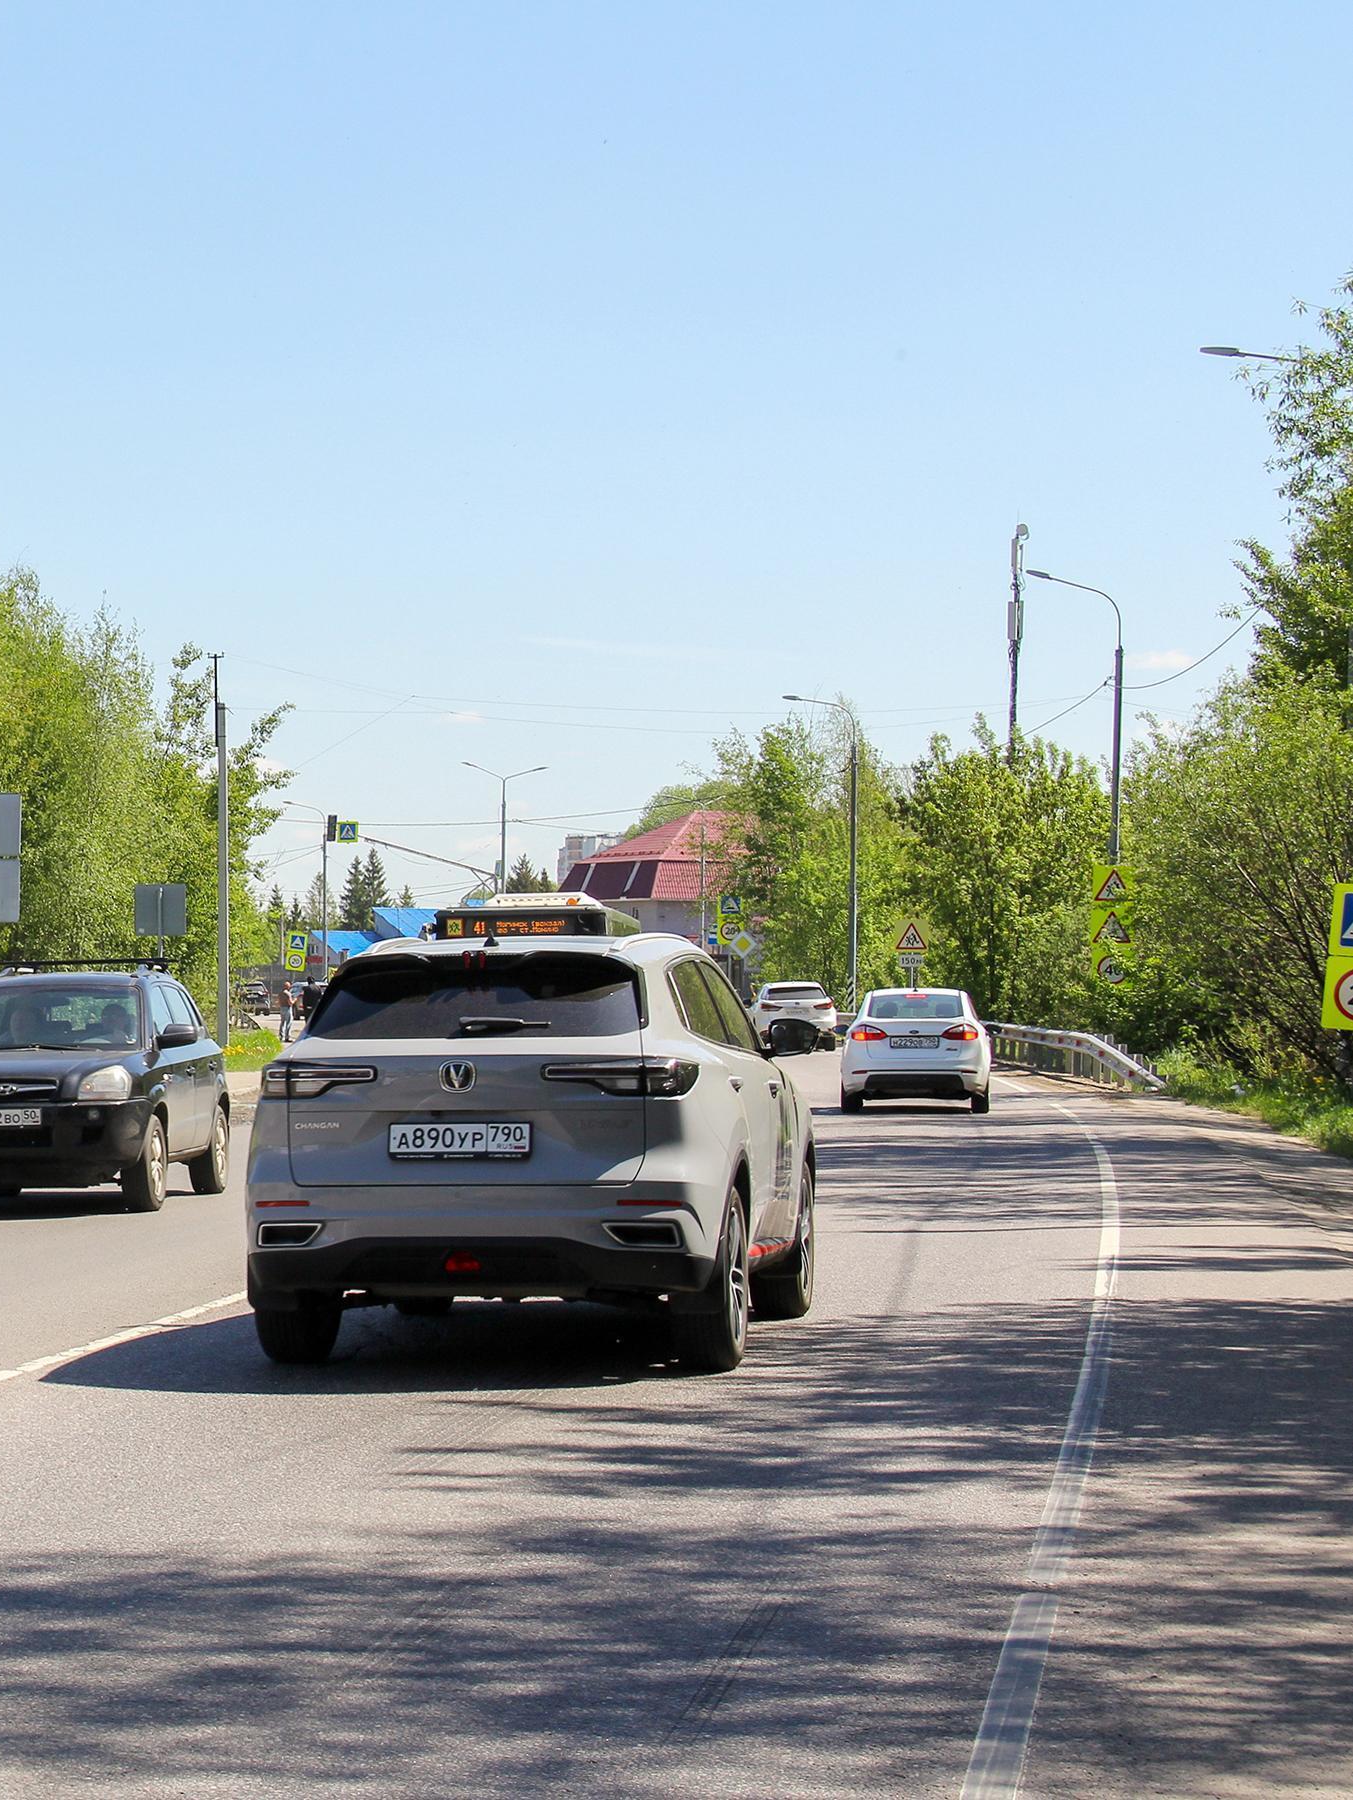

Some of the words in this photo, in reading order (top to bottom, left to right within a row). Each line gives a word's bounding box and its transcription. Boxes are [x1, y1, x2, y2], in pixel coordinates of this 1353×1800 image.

[473, 921, 485, 934] 41
[23, 1110, 37, 1120] 50
[295, 1122, 340, 1130] CHANGAN
[489, 1126, 524, 1142] 790
